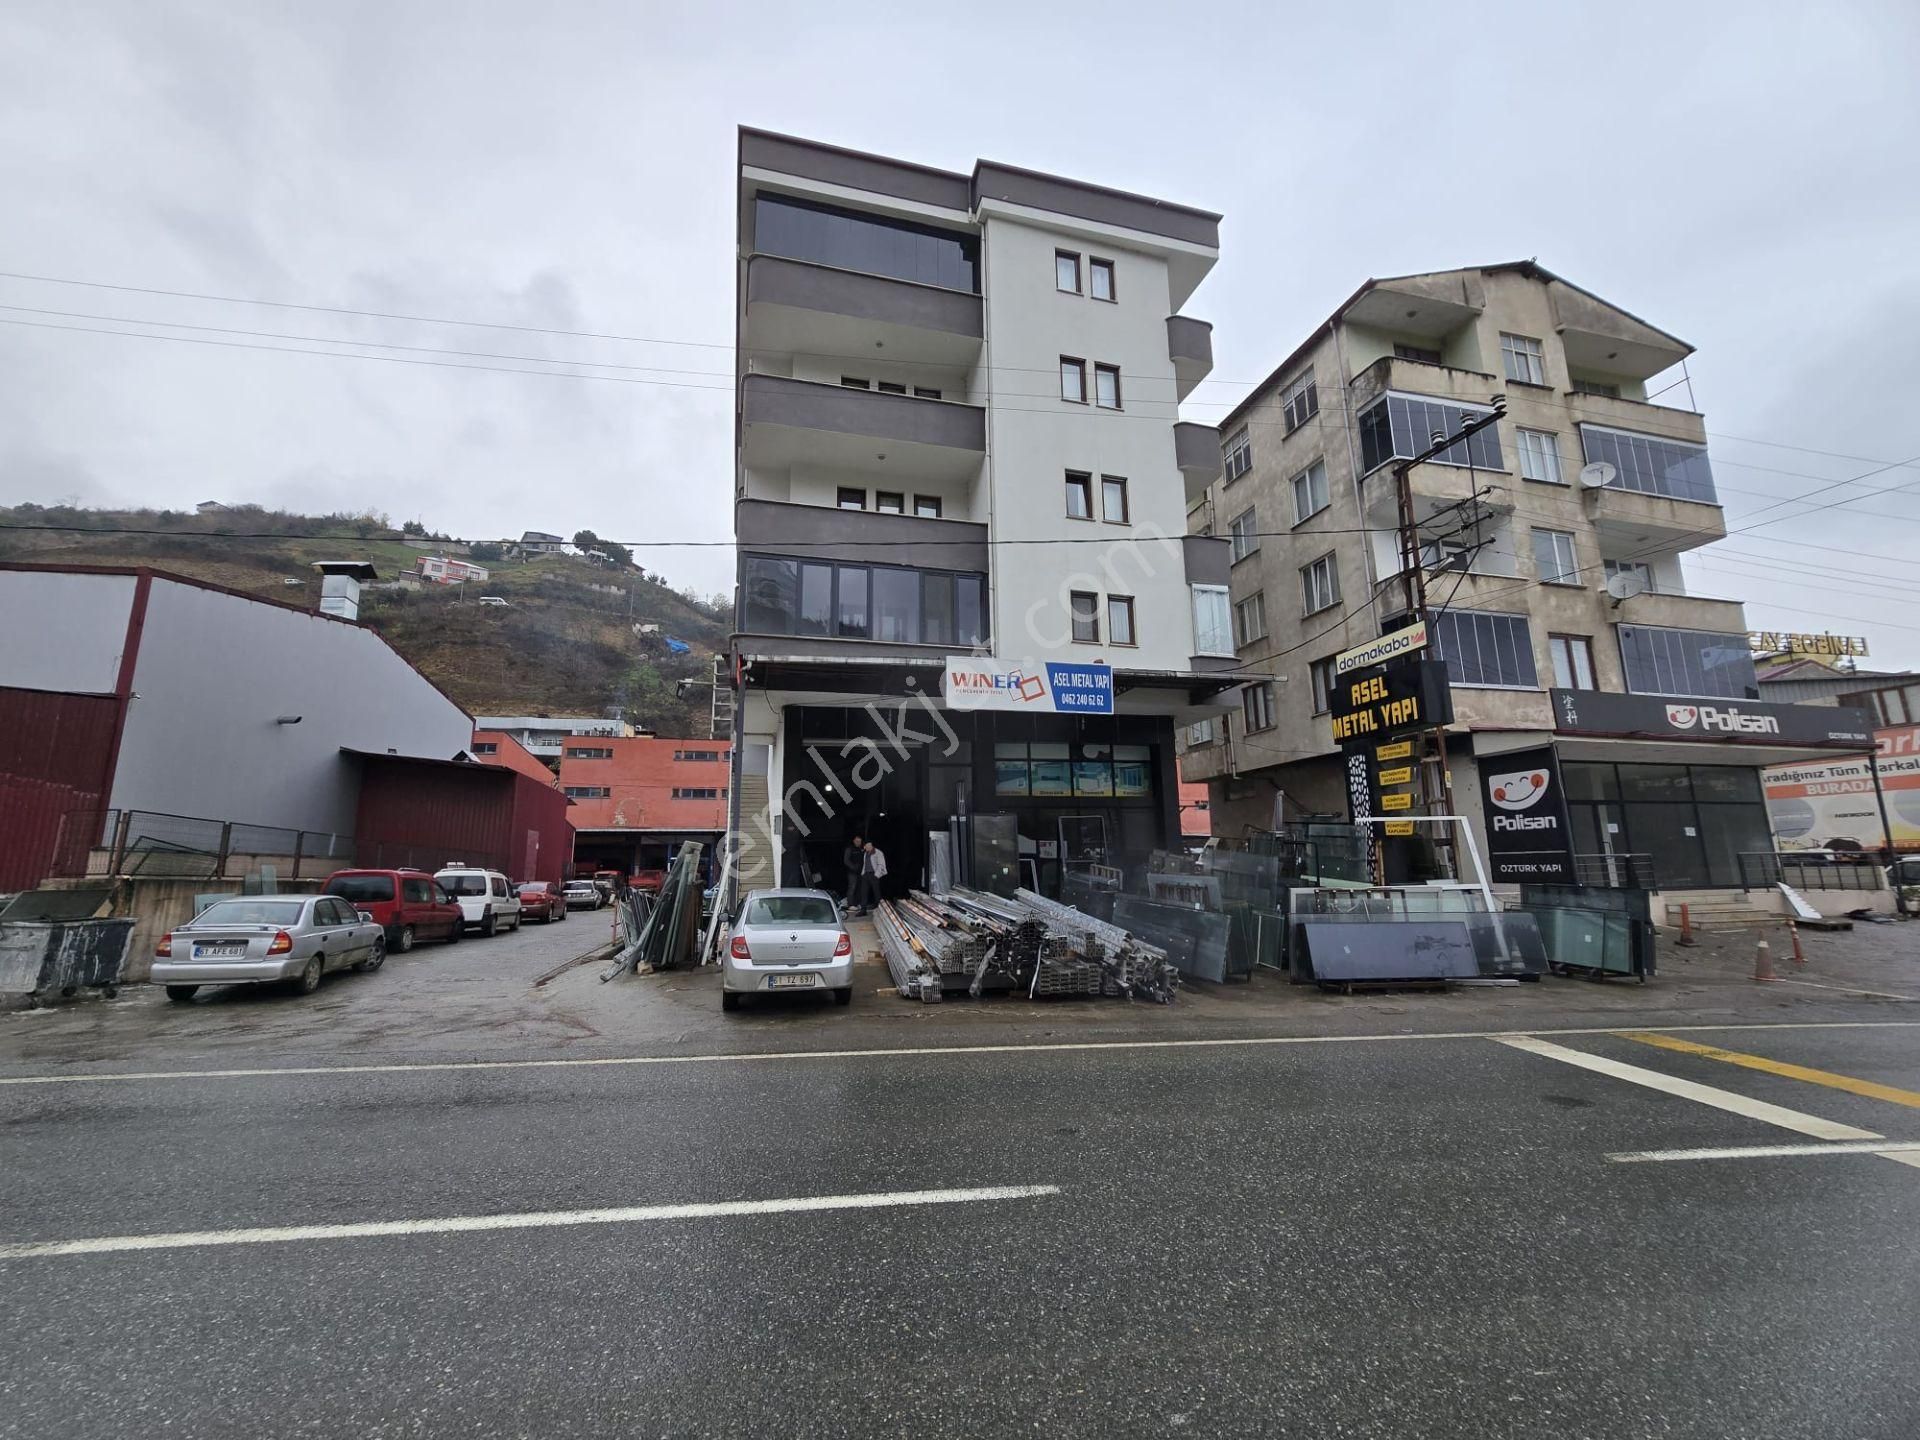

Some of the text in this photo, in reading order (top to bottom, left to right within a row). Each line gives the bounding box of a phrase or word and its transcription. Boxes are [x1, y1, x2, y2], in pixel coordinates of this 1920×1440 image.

[1339, 635, 1410, 670] dormakaba
[951, 672, 1021, 689] WINER
[1053, 672, 1110, 689] ASEL METAL YAPI
[1061, 692, 1104, 707] 0462 240 62 62
[1351, 676, 1389, 706] ASEL
[1332, 696, 1418, 739] METAL YAPI
[1699, 706, 1780, 734] Polisan
[1763, 770, 1825, 783] radığınız
[1826, 766, 1860, 777] Tüm
[1493, 814, 1557, 831] Polisan
[1539, 863, 1562, 872] YAPI
[212, 947, 227, 955] AFE
[787, 976, 796, 984] TZ
